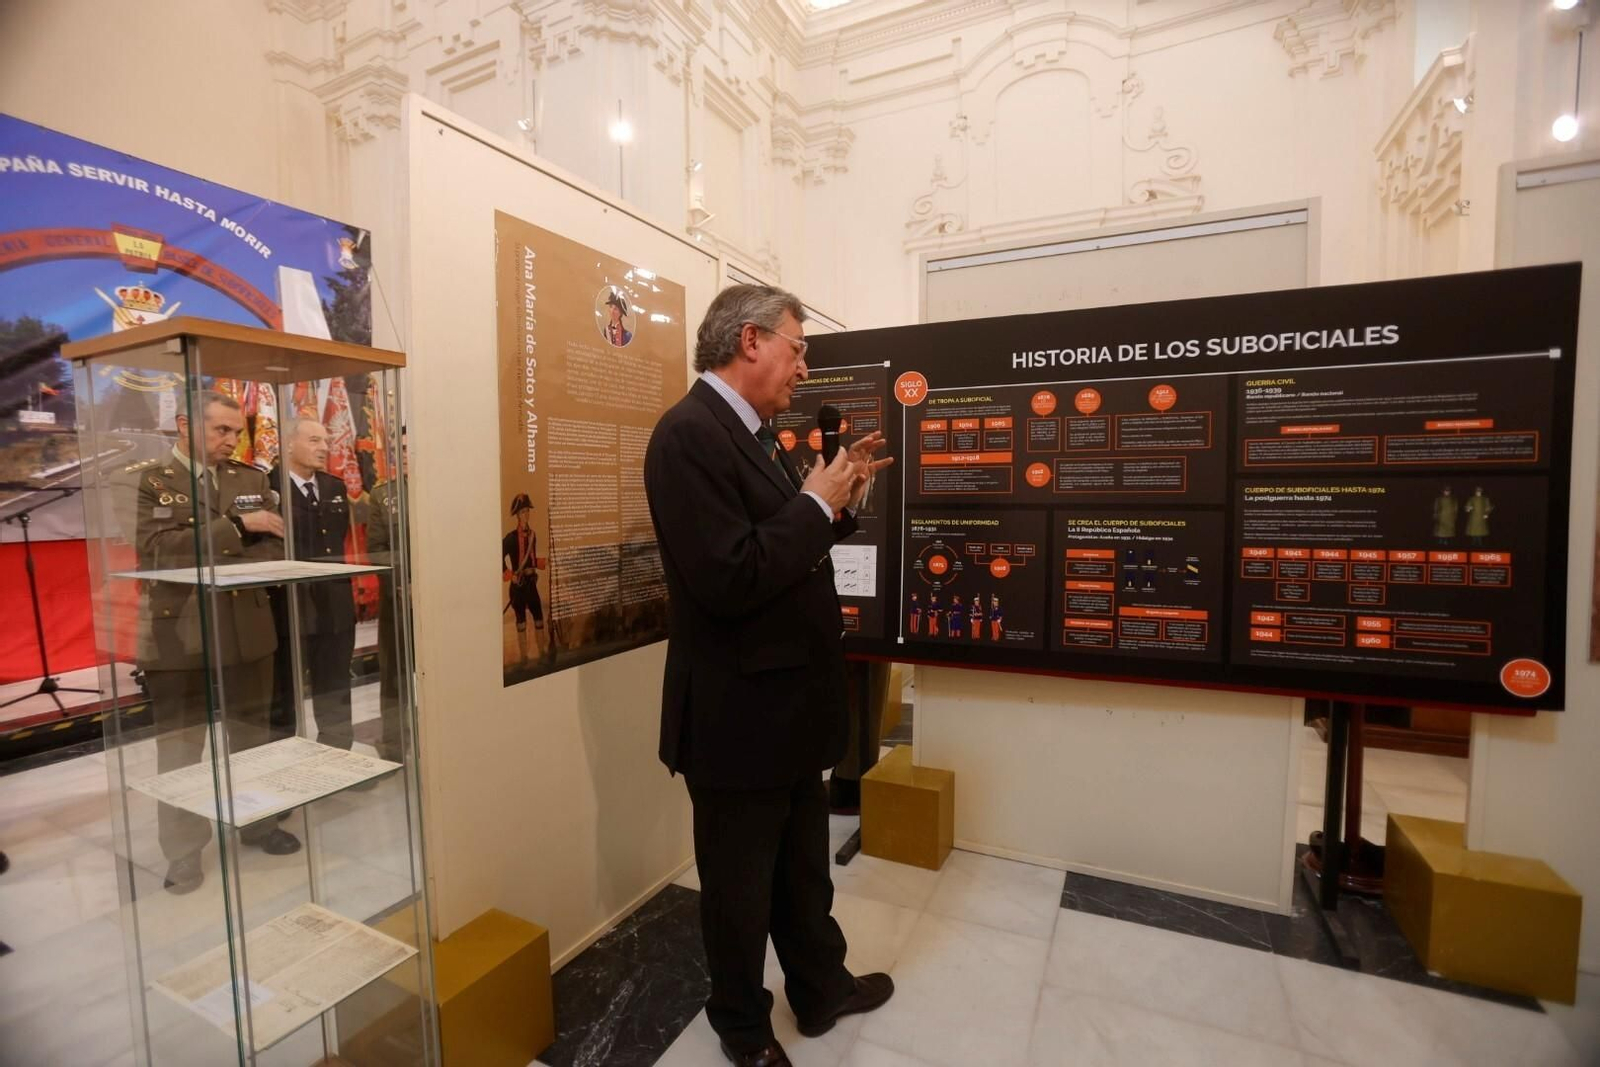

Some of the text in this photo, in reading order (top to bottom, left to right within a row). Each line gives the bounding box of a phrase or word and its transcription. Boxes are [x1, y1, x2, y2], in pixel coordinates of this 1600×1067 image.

[67, 162, 149, 193] SERVIR
[155, 185, 216, 222] HASTA
[220, 217, 272, 259] MORIR
[1012, 325, 1400, 369] HISTORIA DE LOS SUBOFICIALES
[524, 245, 538, 473] Ana María de Soto y Alhama
[900, 380, 923, 388] SIGLO
[1246, 379, 1276, 387] GUERRA
[904, 388, 918, 398] XX
[1358, 551, 1378, 559] 1945
[1514, 669, 1536, 678] 1974
